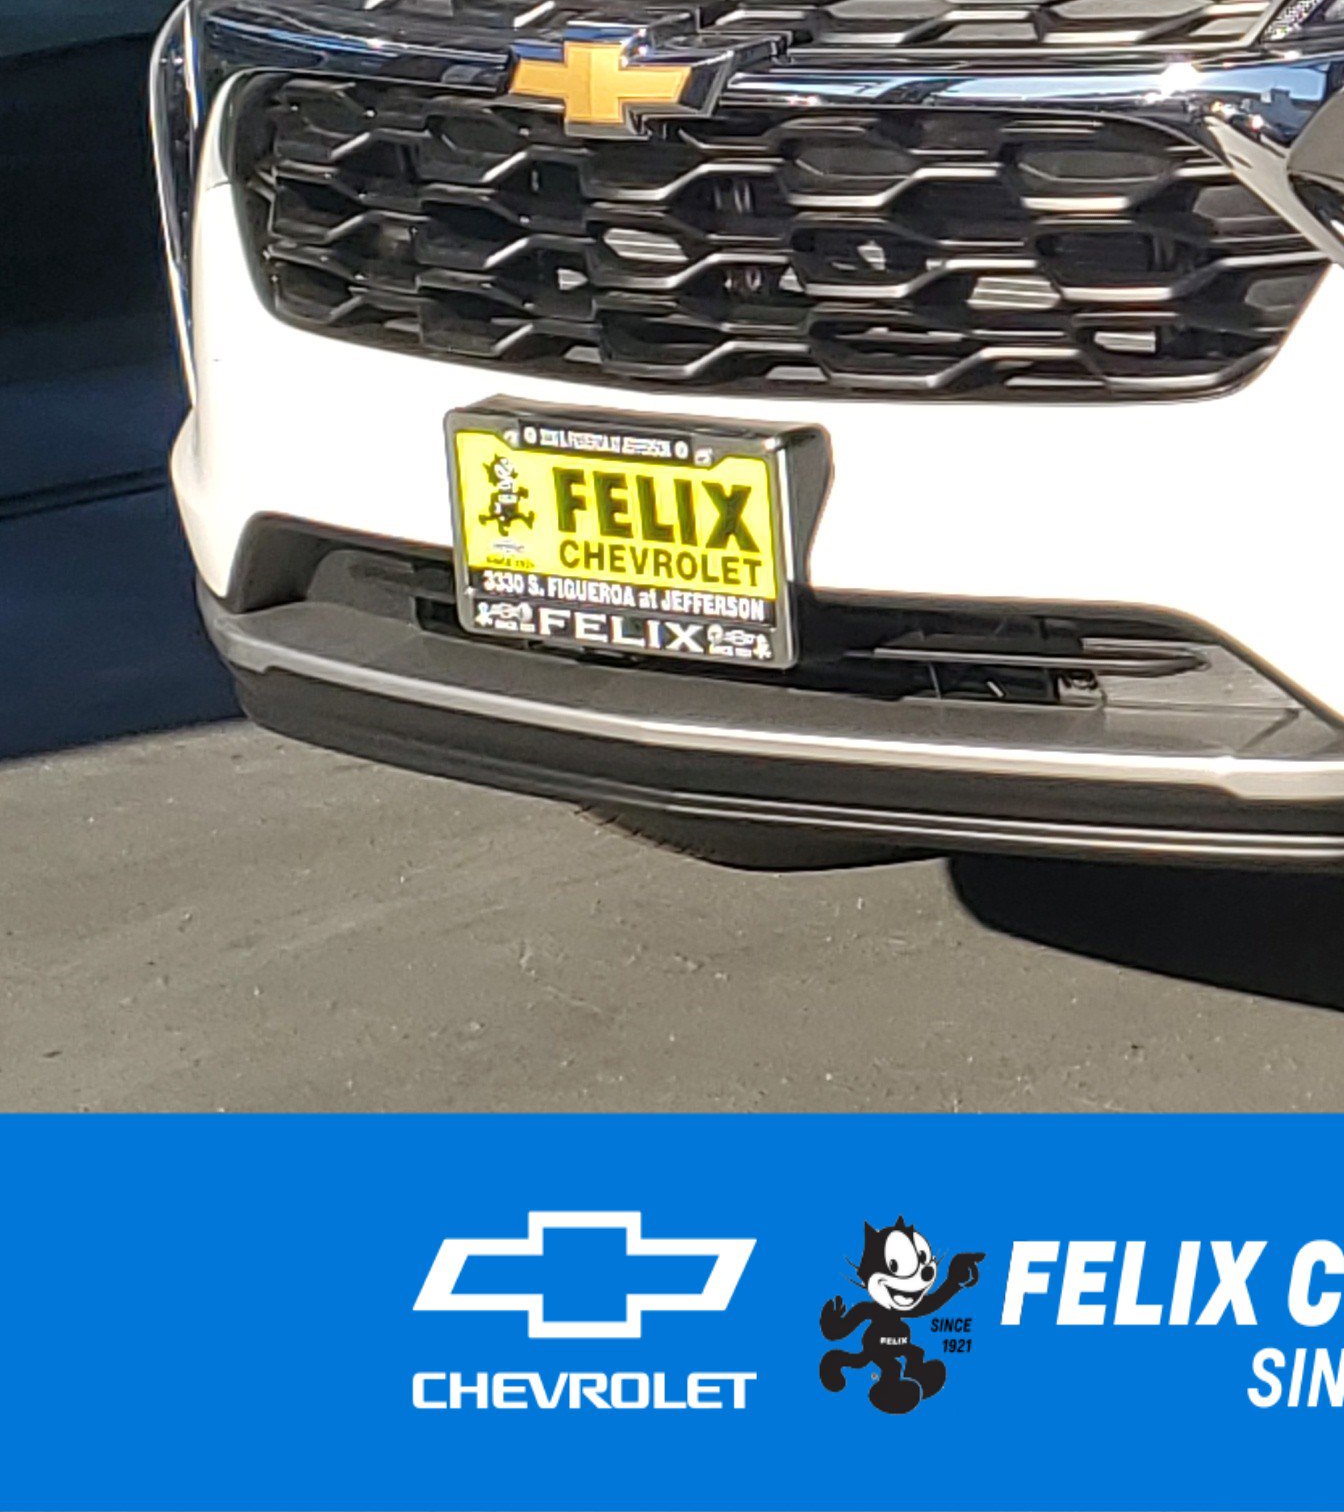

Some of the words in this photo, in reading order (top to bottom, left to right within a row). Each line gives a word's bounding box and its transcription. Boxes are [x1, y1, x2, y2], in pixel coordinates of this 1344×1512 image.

[552, 467, 760, 553] FELIX
[559, 540, 762, 587] CHEVROLET
[483, 570, 524, 594] 3330
[528, 573, 544, 597] S.
[548, 576, 635, 607] FIGUEROA
[661, 589, 764, 621] JEFFERSON
[539, 607, 704, 654] FELIX
